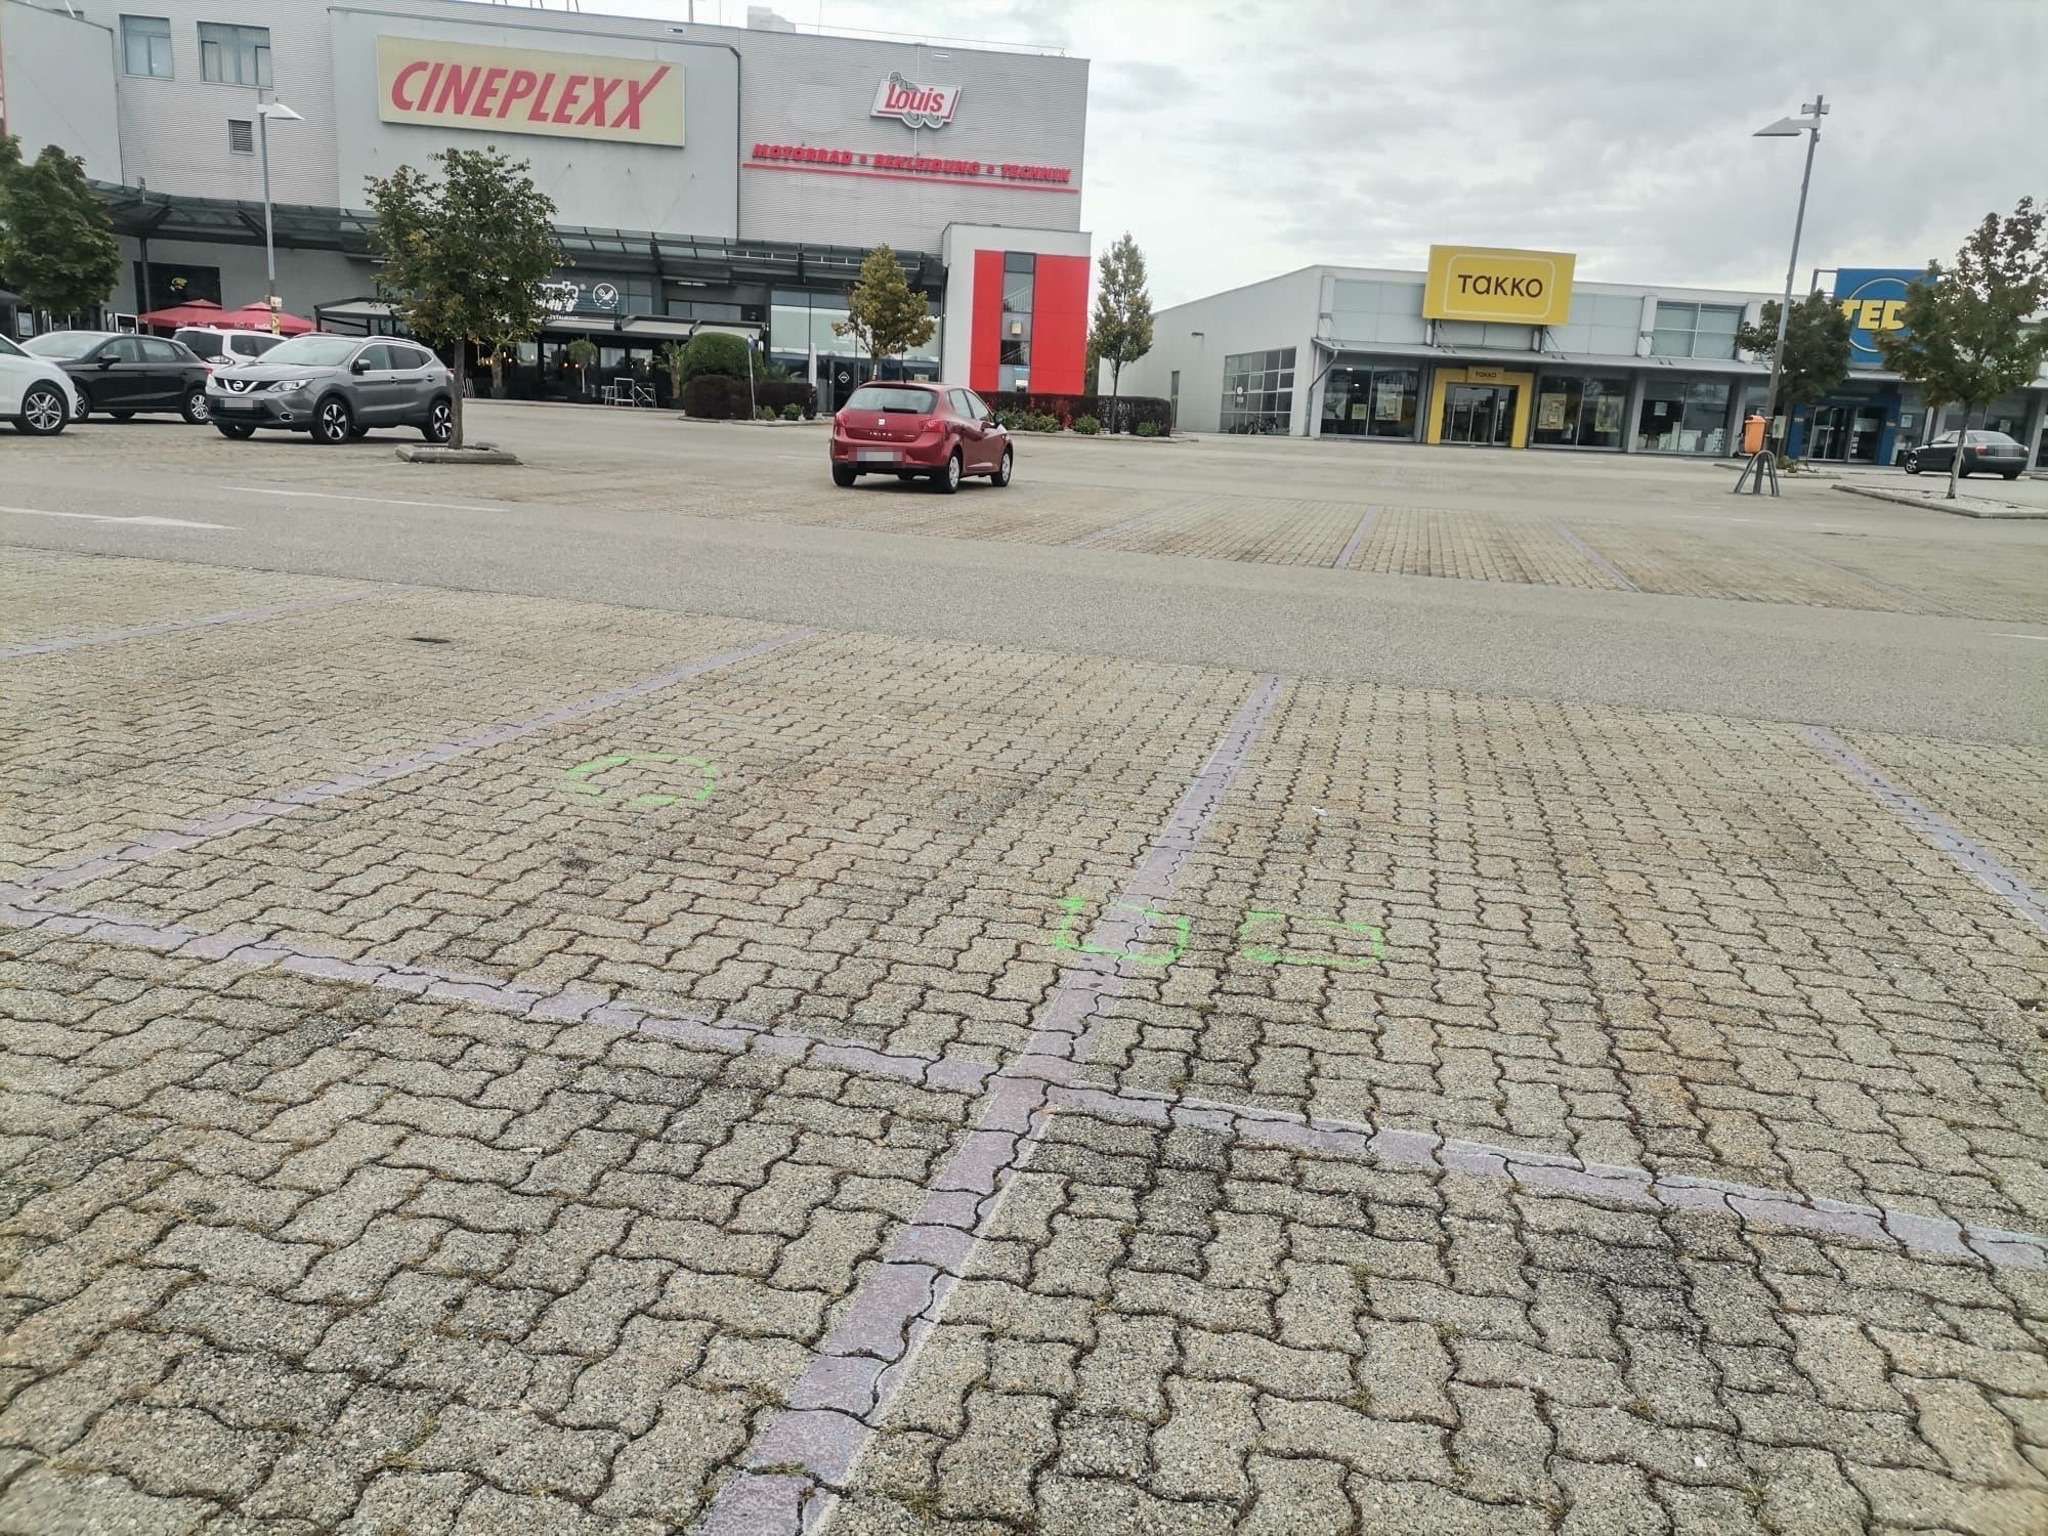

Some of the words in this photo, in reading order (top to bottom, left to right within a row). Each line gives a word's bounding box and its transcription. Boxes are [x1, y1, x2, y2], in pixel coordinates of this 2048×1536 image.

[390, 60, 671, 130] CINEPLEXX
[885, 83, 945, 113] Louis
[1841, 299, 1905, 331] TED
